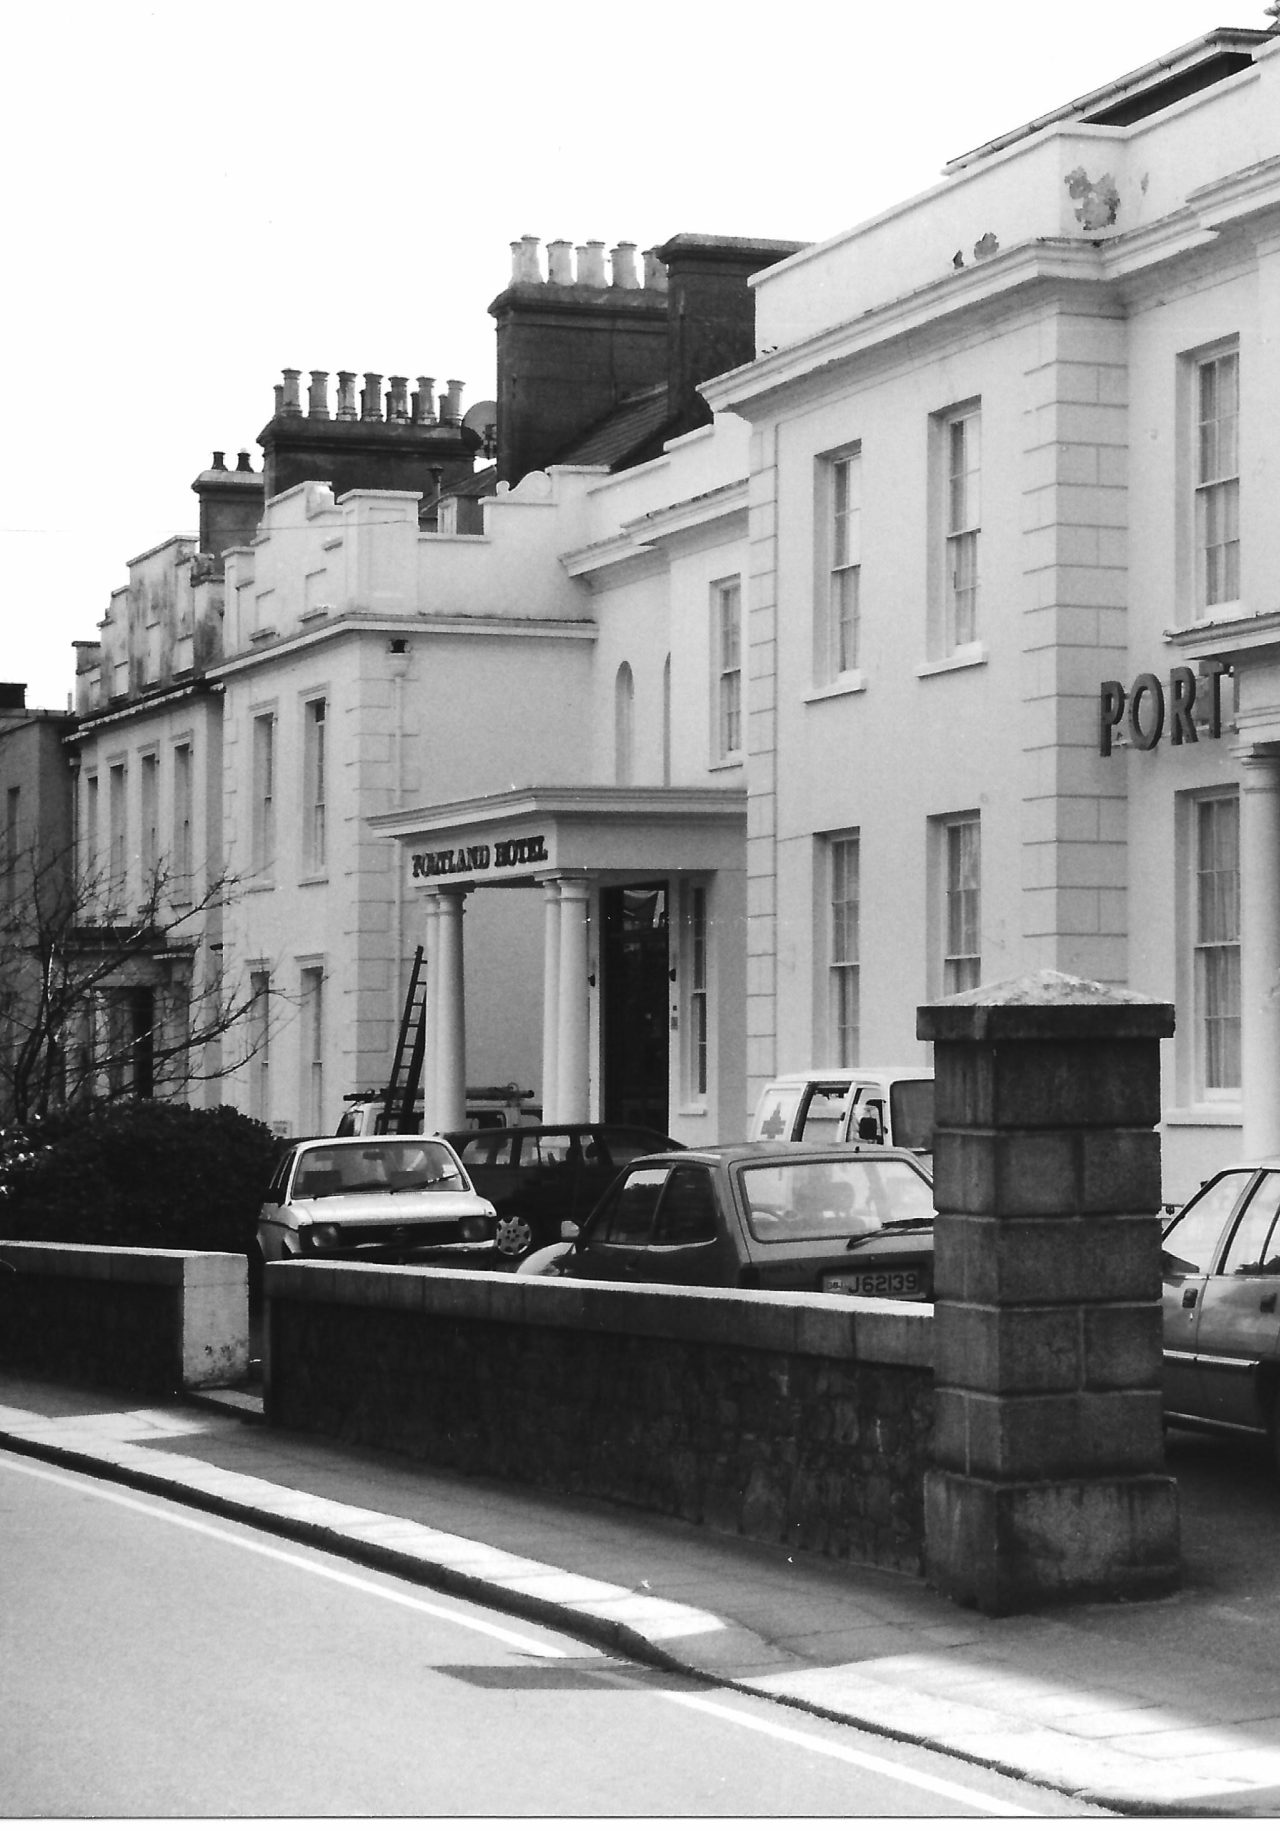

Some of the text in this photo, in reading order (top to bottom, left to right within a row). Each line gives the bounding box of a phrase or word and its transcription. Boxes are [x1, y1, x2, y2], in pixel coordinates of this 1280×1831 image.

[412, 835, 548, 878] PORTLAND HOTEL
[848, 1273, 917, 1294] J62139
